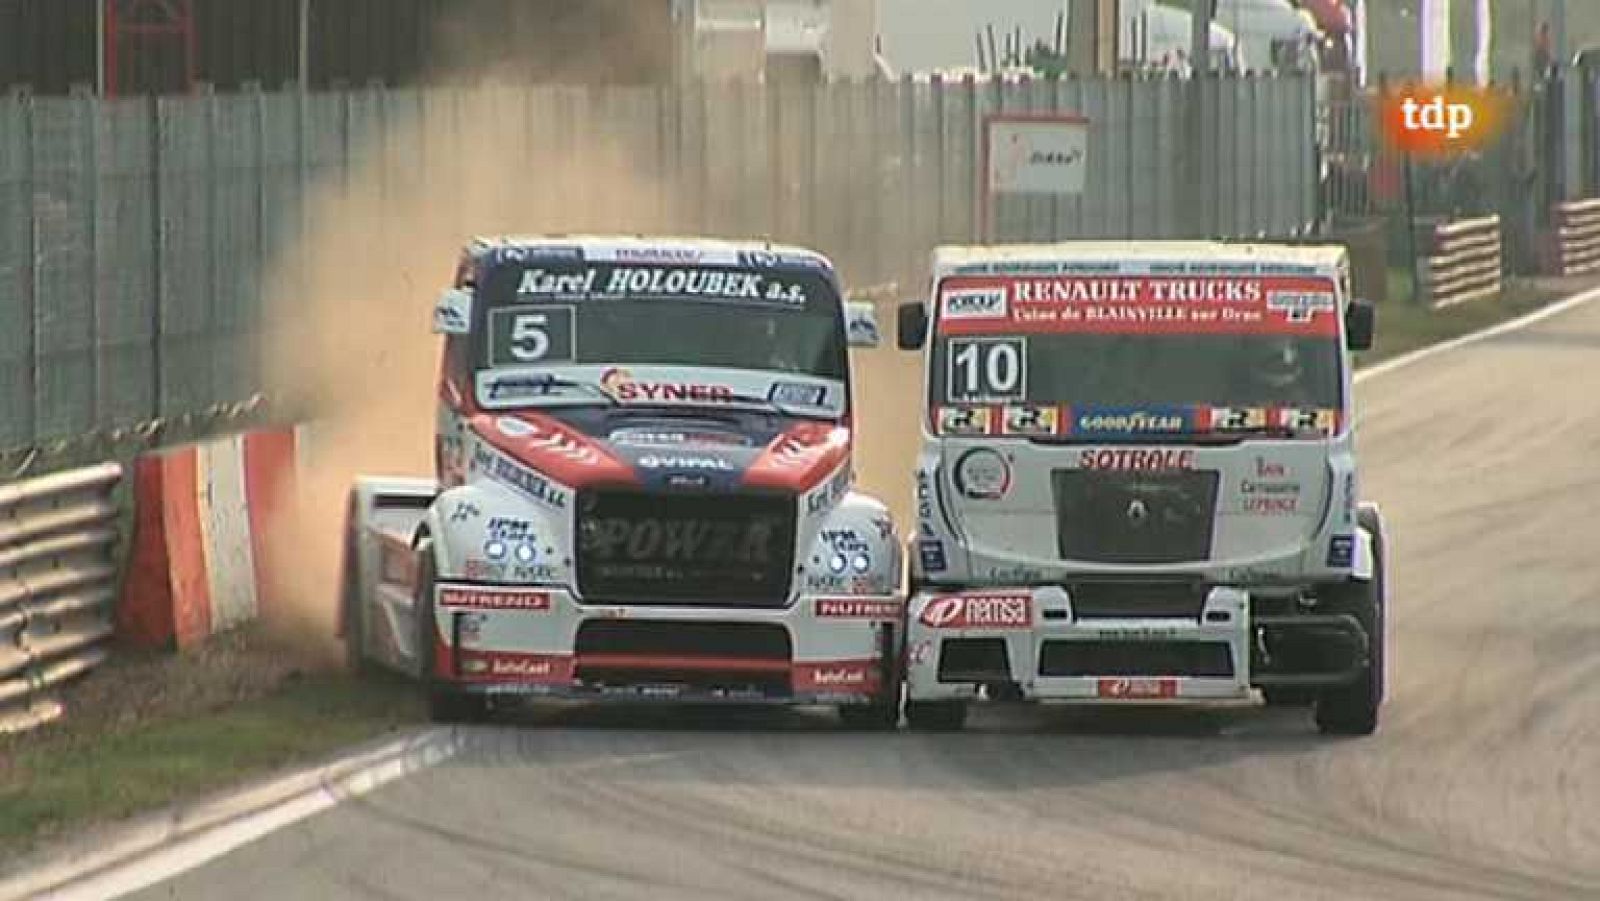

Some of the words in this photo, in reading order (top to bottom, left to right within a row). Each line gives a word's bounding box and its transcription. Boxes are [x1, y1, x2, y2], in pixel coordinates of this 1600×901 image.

[516, 268, 597, 294] Karel
[605, 267, 763, 298] HOLOUBEK
[765, 281, 808, 304] a.s.
[1013, 280, 1141, 301] RENAULT
[1150, 280, 1261, 301] TRUCKS
[510, 314, 549, 360] 5
[955, 343, 1019, 392] 10
[617, 382, 734, 403] SYNER
[1080, 411, 1184, 434] GOODYEAR
